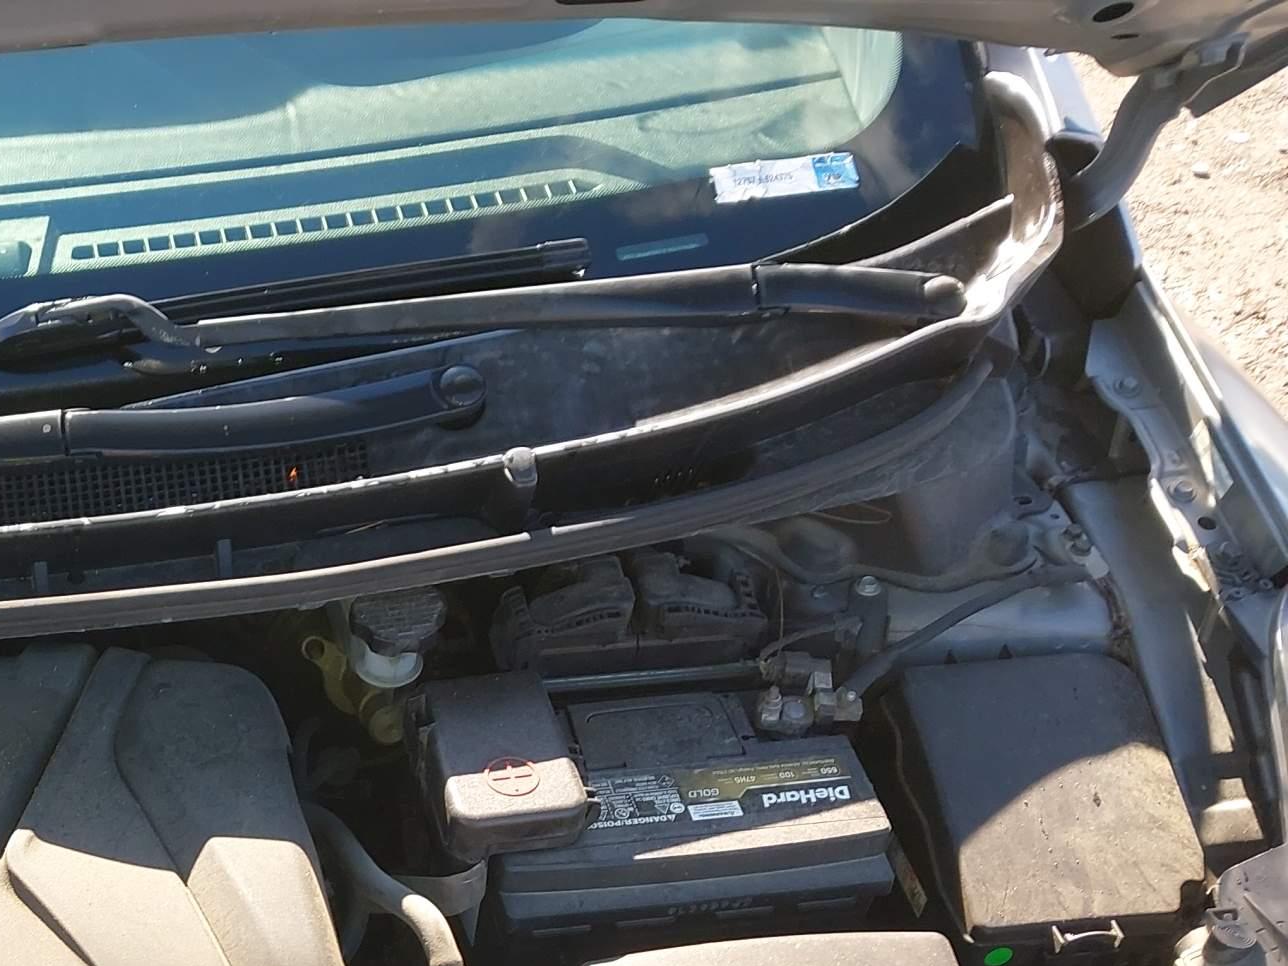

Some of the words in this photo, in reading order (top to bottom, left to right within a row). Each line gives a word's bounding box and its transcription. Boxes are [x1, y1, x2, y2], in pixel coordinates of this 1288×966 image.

[688, 787, 720, 799] GOLD
[761, 784, 851, 808] DieHard
[587, 814, 668, 829] DANGER/POISO
